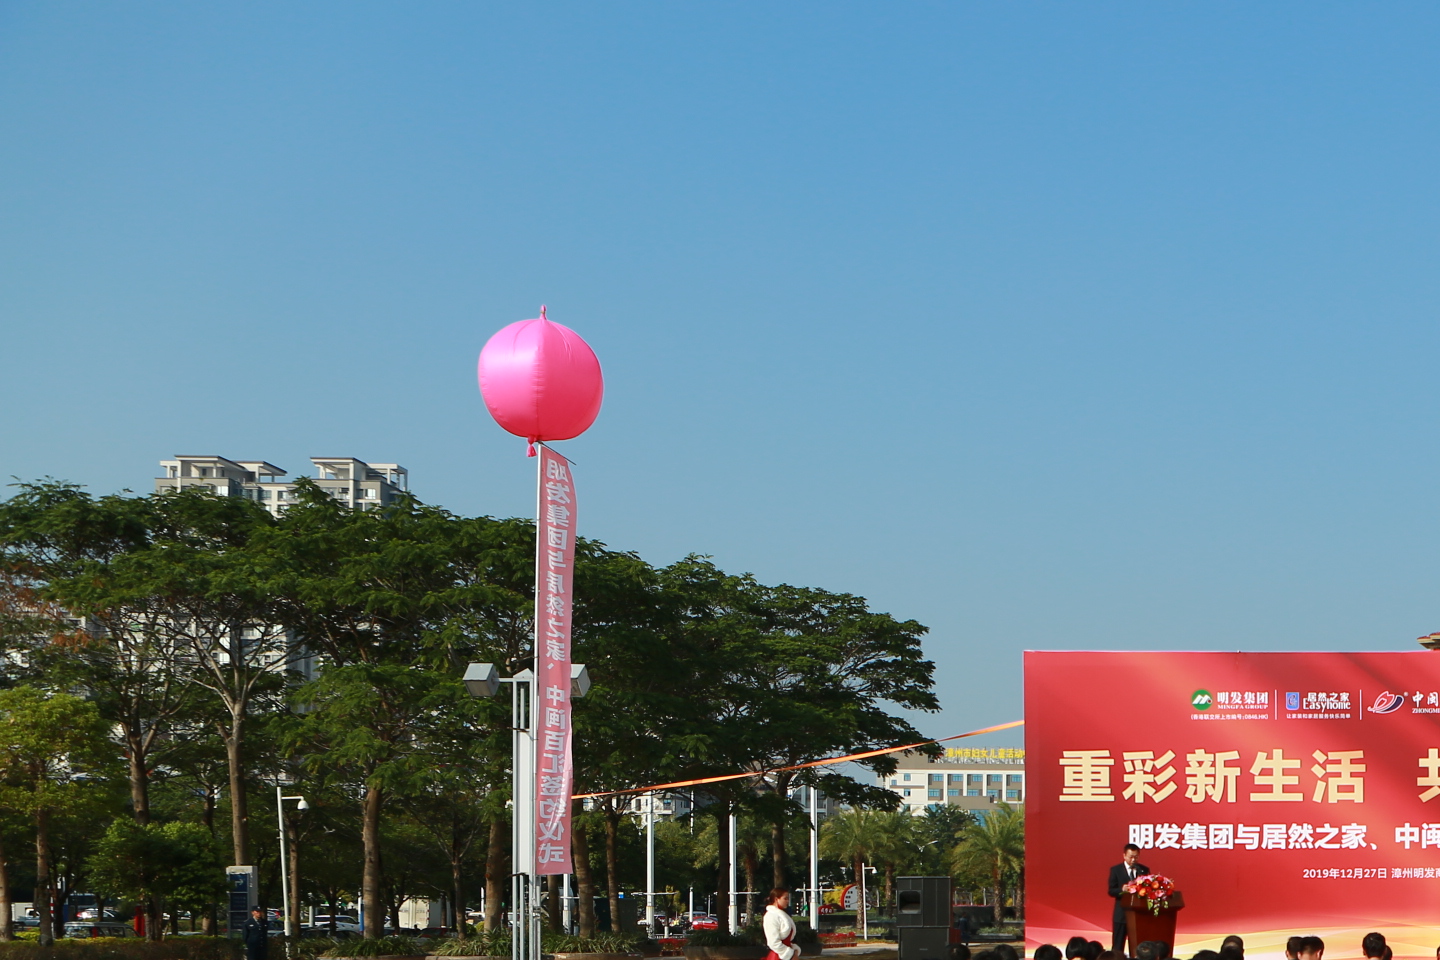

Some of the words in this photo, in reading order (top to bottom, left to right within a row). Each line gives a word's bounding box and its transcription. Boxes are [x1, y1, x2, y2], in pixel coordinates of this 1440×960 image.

[1217, 691, 1269, 705] 明发集团
[1307, 692, 1350, 702] 居然之家
[1303, 697, 1351, 712] Easyhome
[945, 748, 1025, 759] 漳州市妇女儿童活动
[1059, 748, 1366, 804] 重彩新生活
[1302, 867, 1387, 879] 2019年12月27日
